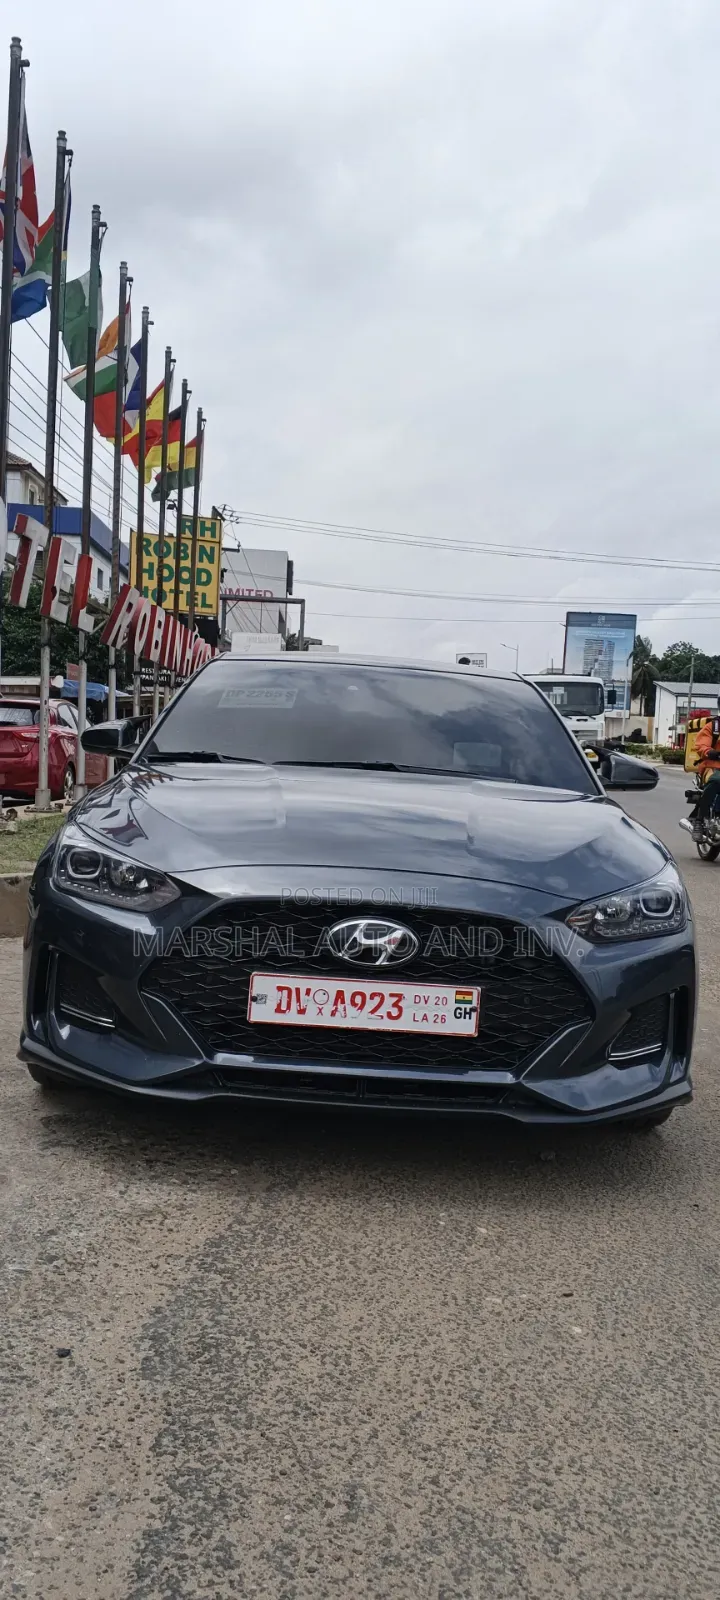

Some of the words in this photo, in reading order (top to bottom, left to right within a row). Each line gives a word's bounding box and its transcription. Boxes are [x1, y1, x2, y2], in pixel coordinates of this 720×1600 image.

[180, 518, 217, 539] RH
[138, 537, 216, 564] ROBN
[274, 985, 312, 1015] DV
[330, 989, 405, 1021] A923
[413, 994, 430, 1005] DV
[434, 995, 448, 1006] 20
[413, 1013, 429, 1023] LA
[433, 1013, 447, 1024] 26
[453, 1006, 473, 1020] GH
